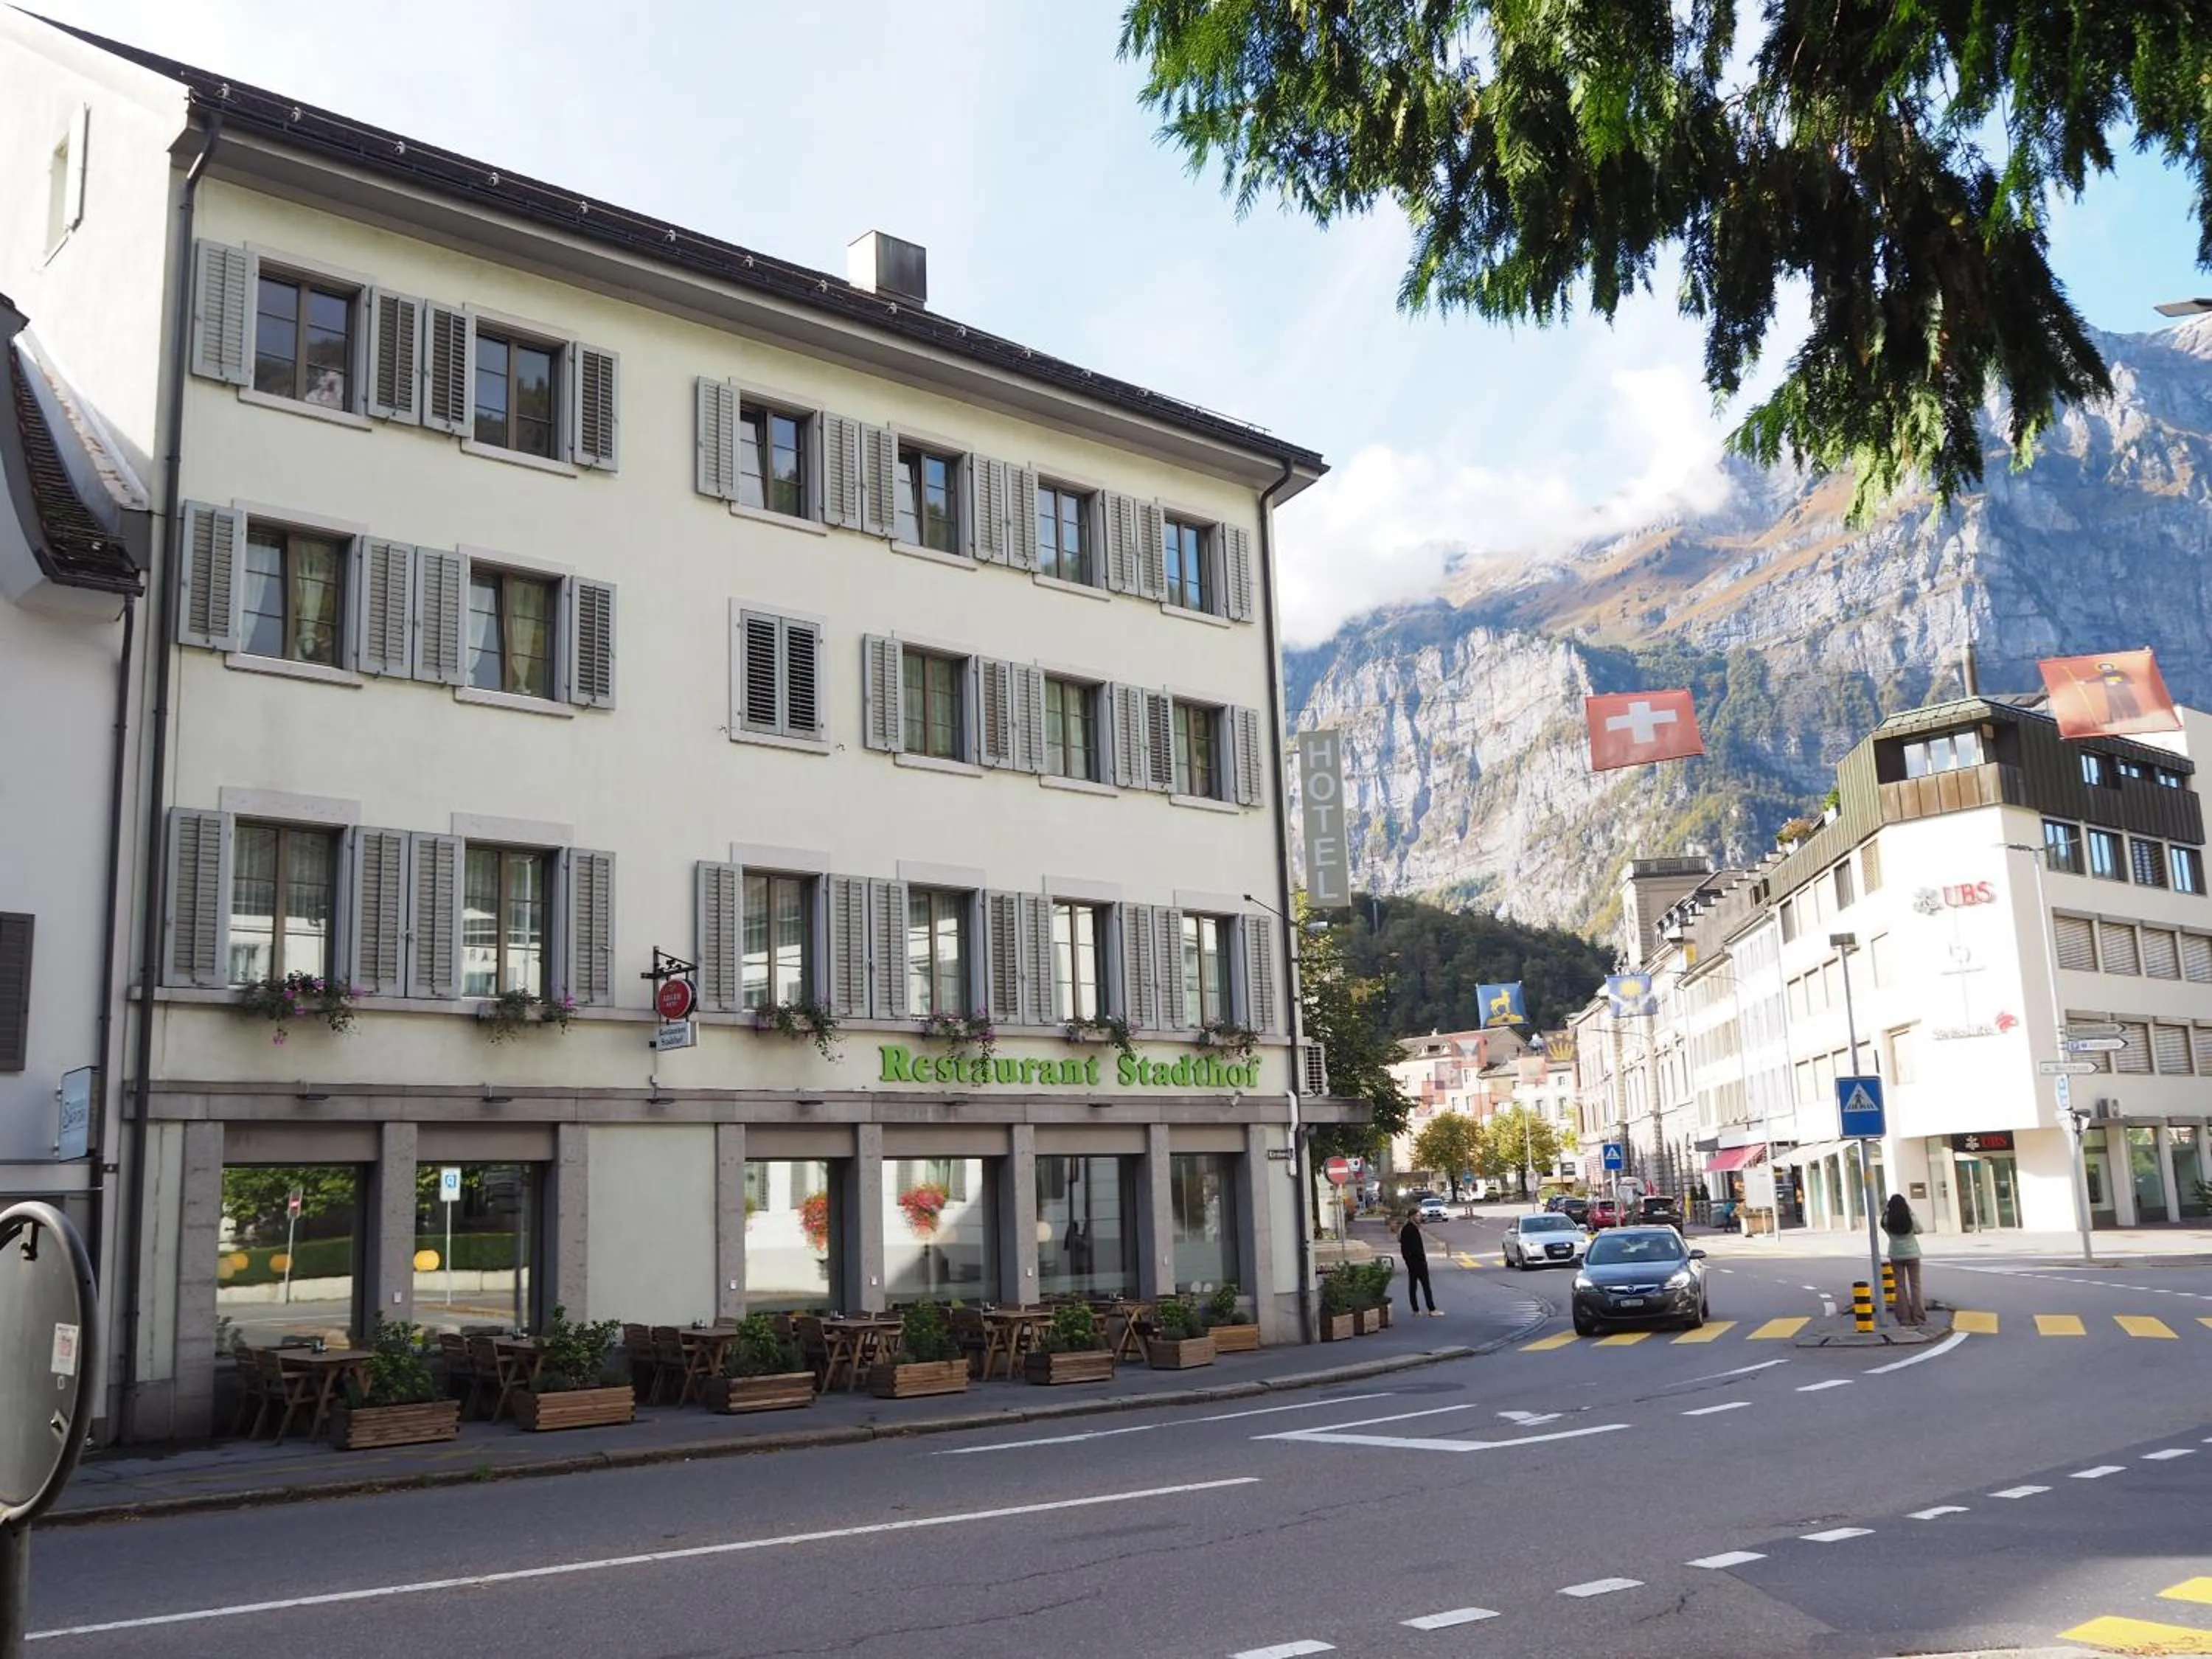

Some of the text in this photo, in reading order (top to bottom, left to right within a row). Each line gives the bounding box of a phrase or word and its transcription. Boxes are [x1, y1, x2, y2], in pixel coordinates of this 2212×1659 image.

[1308, 740, 1338, 899] HOTEL
[1943, 881, 1995, 907] UBS
[880, 1045, 1262, 1088] Restaurant Stadthof
[1981, 1134, 2006, 1147] UBS
